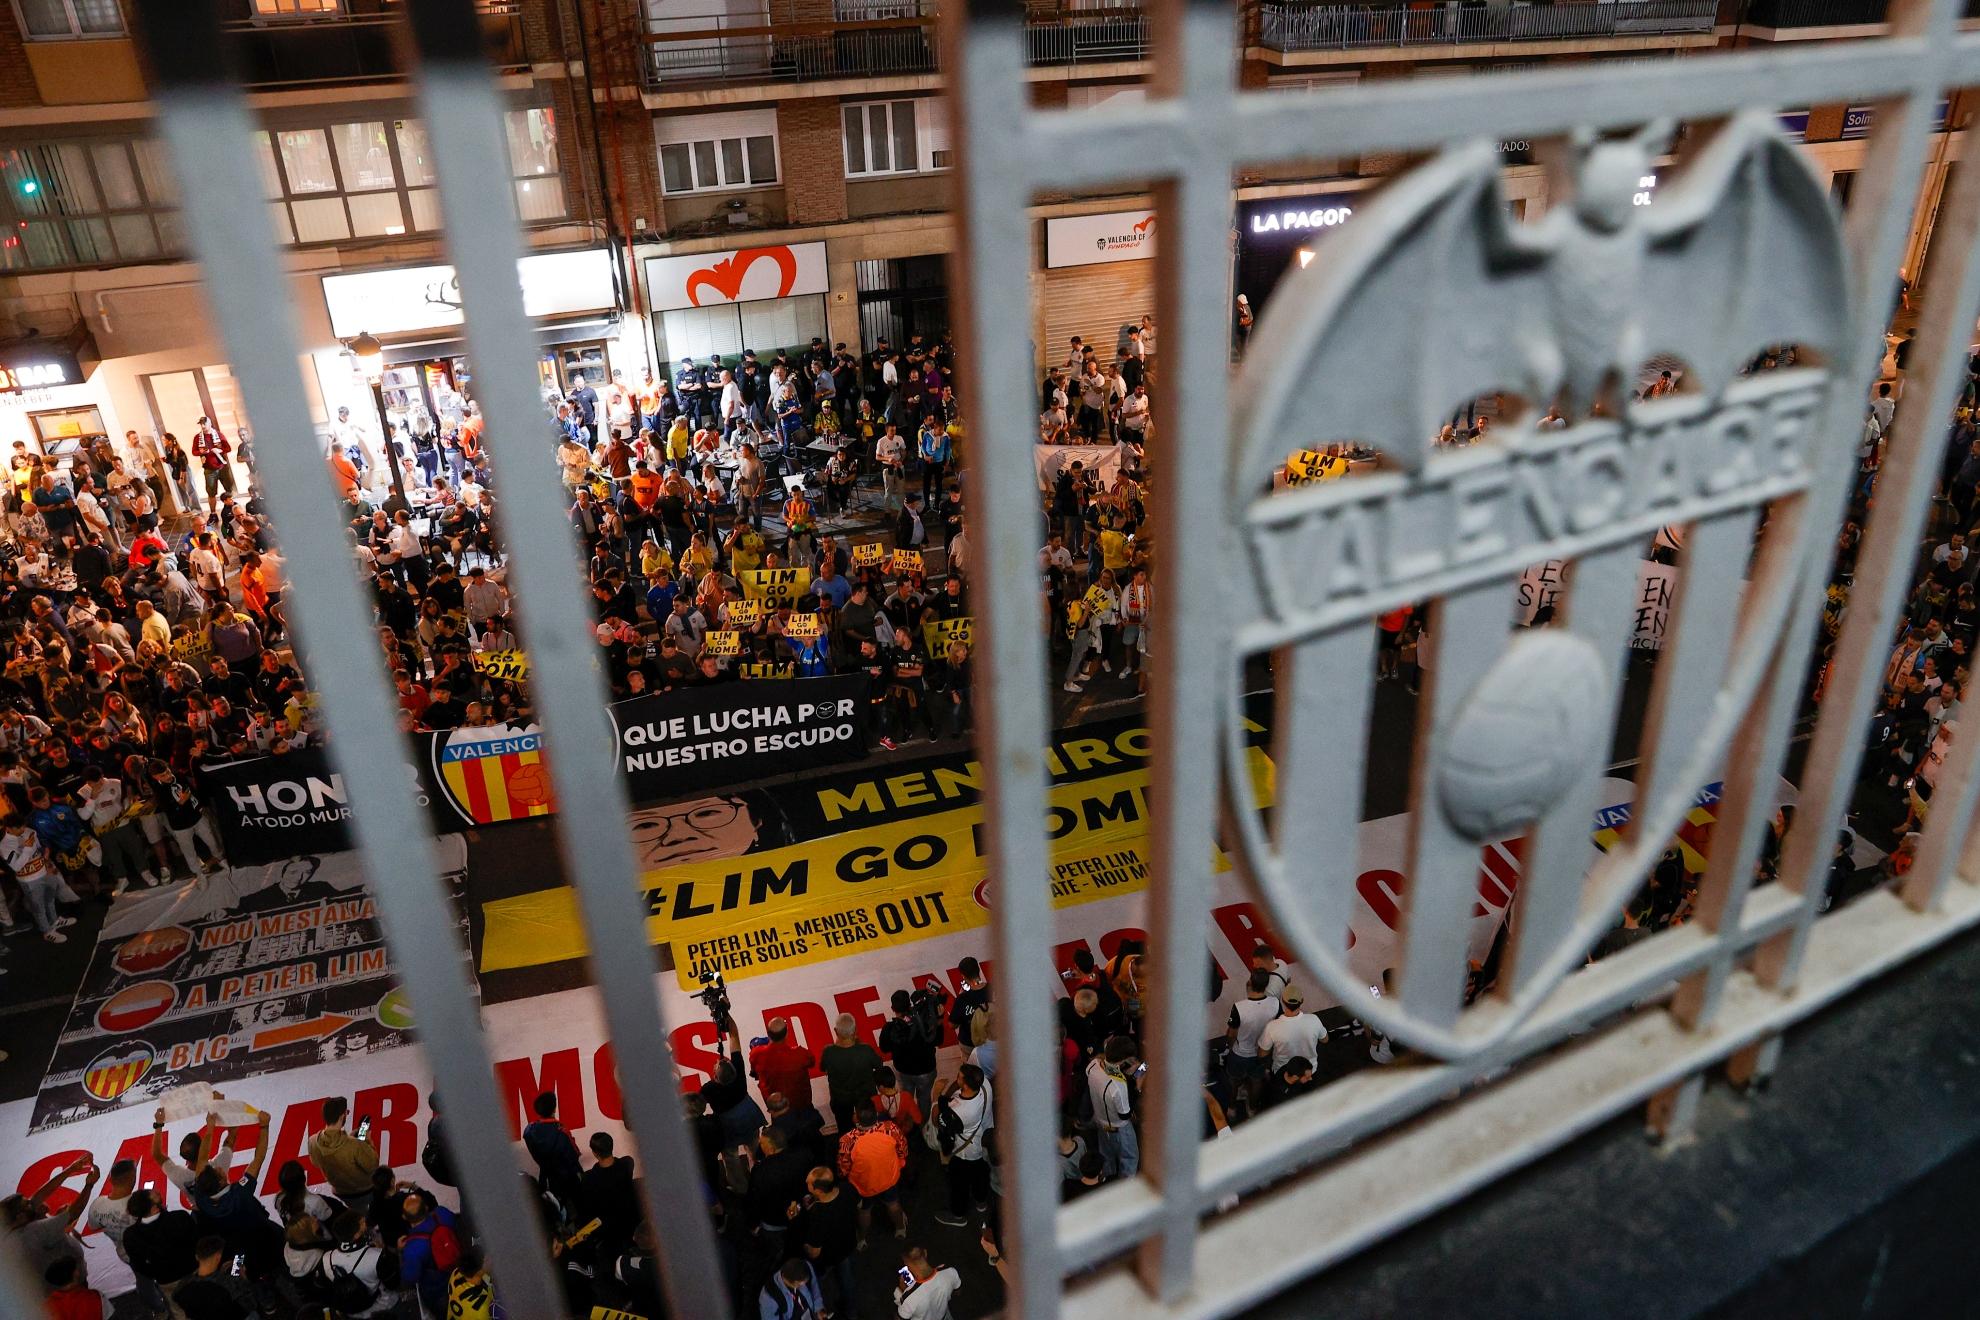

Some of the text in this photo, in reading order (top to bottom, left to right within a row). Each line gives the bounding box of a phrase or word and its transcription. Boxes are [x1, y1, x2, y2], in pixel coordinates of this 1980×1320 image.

[1253, 214, 1280, 232] LA
[1107, 233, 1146, 244] VALENCIA CF
[1299, 451, 1336, 469] LIM
[1305, 466, 1324, 477] GO
[859, 544, 877, 554] LIM
[898, 550, 916, 558] LIM
[857, 557, 882, 566] HOME
[895, 561, 921, 570] HOME
[756, 569, 797, 585] LIM
[766, 585, 788, 595] GO
[735, 601, 754, 610] LIM
[730, 613, 758, 623] HOME
[791, 614, 812, 623] LIM
[712, 632, 733, 640] LIM
[787, 628, 818, 636] HOME
[706, 645, 738, 654] HOME
[623, 717, 687, 746] QUE
[693, 705, 792, 736] LUCHA
[450, 735, 543, 760] VALENCI
[625, 723, 854, 773] NUESTRO ESCUDO
[253, 813, 306, 829] TODO
[835, 834, 948, 882] GO
[1055, 857, 1106, 879] PETER
[1105, 850, 1140, 868] LIM
[1091, 868, 1130, 889] NOU
[875, 891, 950, 935] OUT
[203, 920, 253, 949] NOU
[687, 935, 740, 960] PETER
[743, 927, 779, 947] LIM
[794, 908, 869, 937] MENDES
[687, 950, 753, 979] JAVIER
[757, 938, 809, 963] SOLIS
[822, 923, 879, 949] TEBAS
[187, 986, 204, 1009] A
[221, 962, 317, 1001] PETER
[331, 949, 386, 978] LIM
[170, 1035, 230, 1070] BIC
